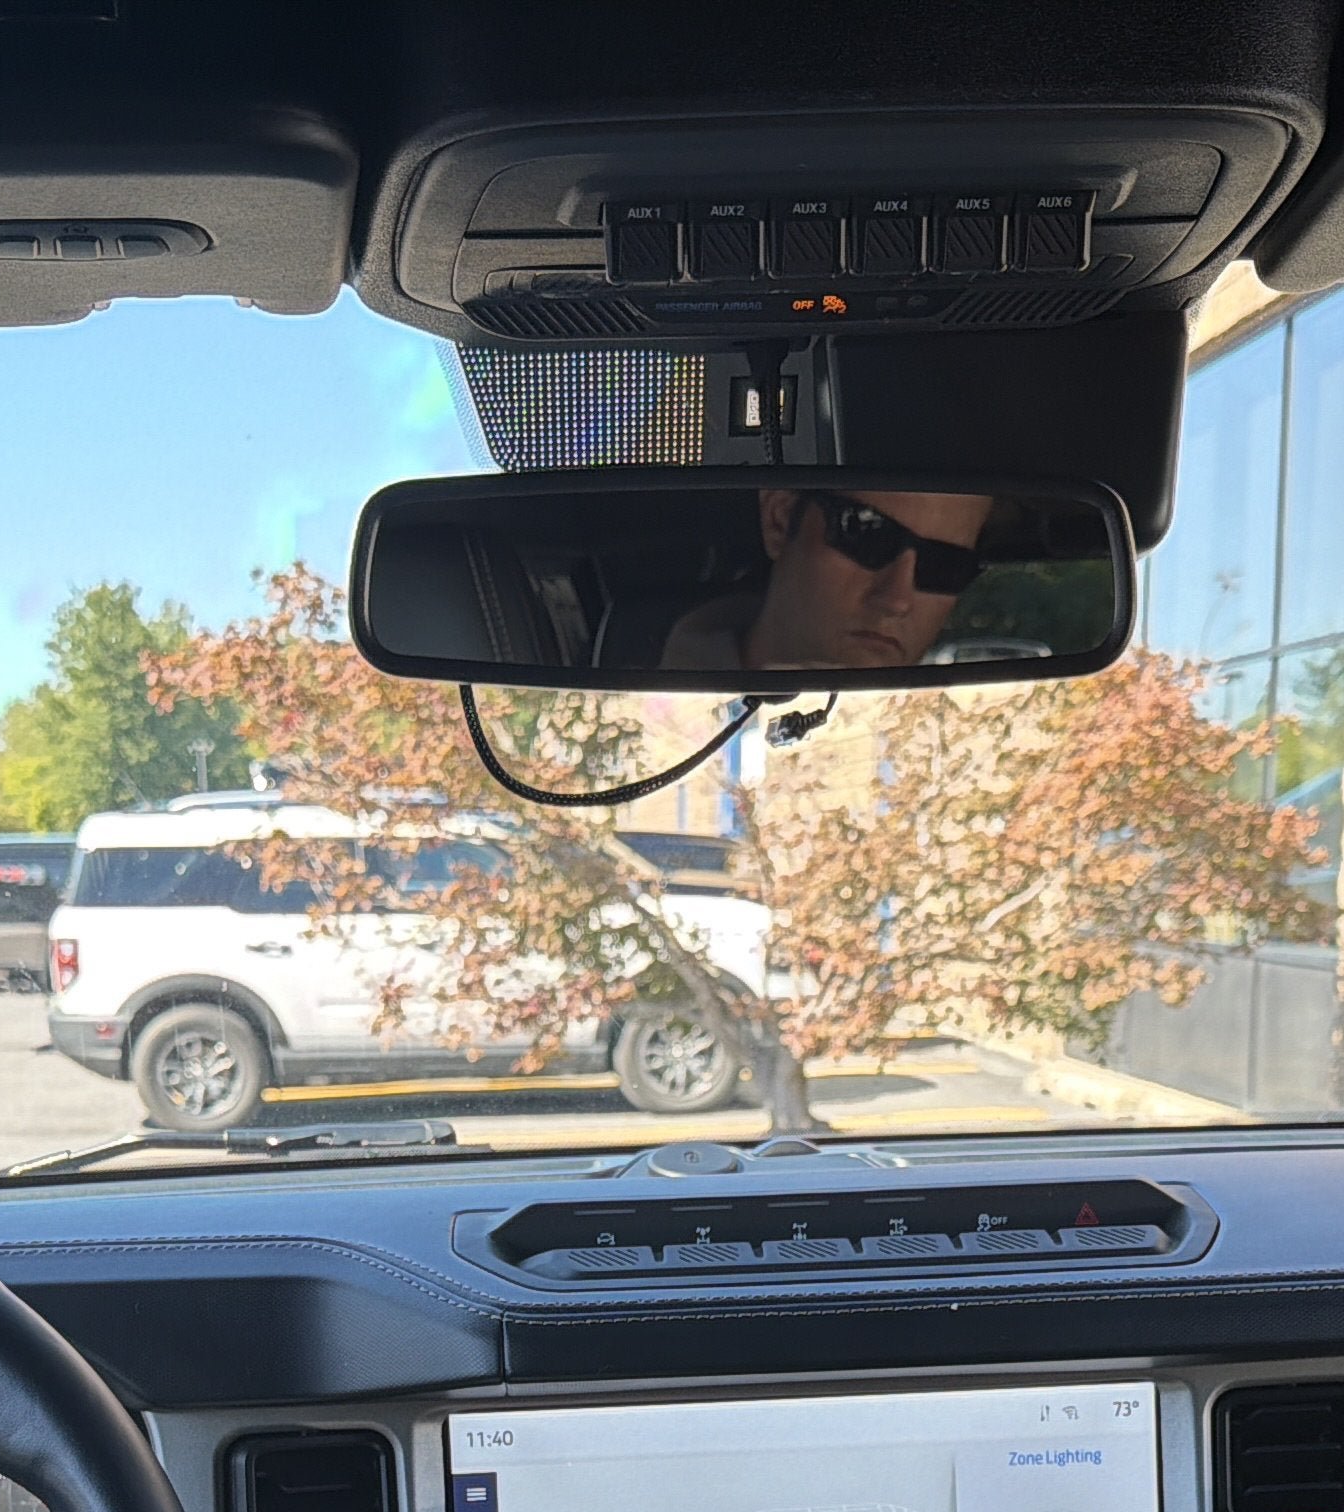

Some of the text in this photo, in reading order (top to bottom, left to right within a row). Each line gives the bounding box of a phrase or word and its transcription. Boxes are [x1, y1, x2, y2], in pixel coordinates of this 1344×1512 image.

[792, 202, 827, 214] AUX3
[874, 200, 908, 212] AUX4
[955, 198, 991, 210] AUX5
[1037, 196, 1072, 208] AUX6
[627, 206, 662, 219] AUX1
[710, 204, 745, 217] AUX2
[791, 299, 816, 311] OFF
[990, 1215, 1008, 1226] OFF
[466, 1429, 514, 1449] 11:40
[1008, 1446, 1103, 1468] Zone Lighting
